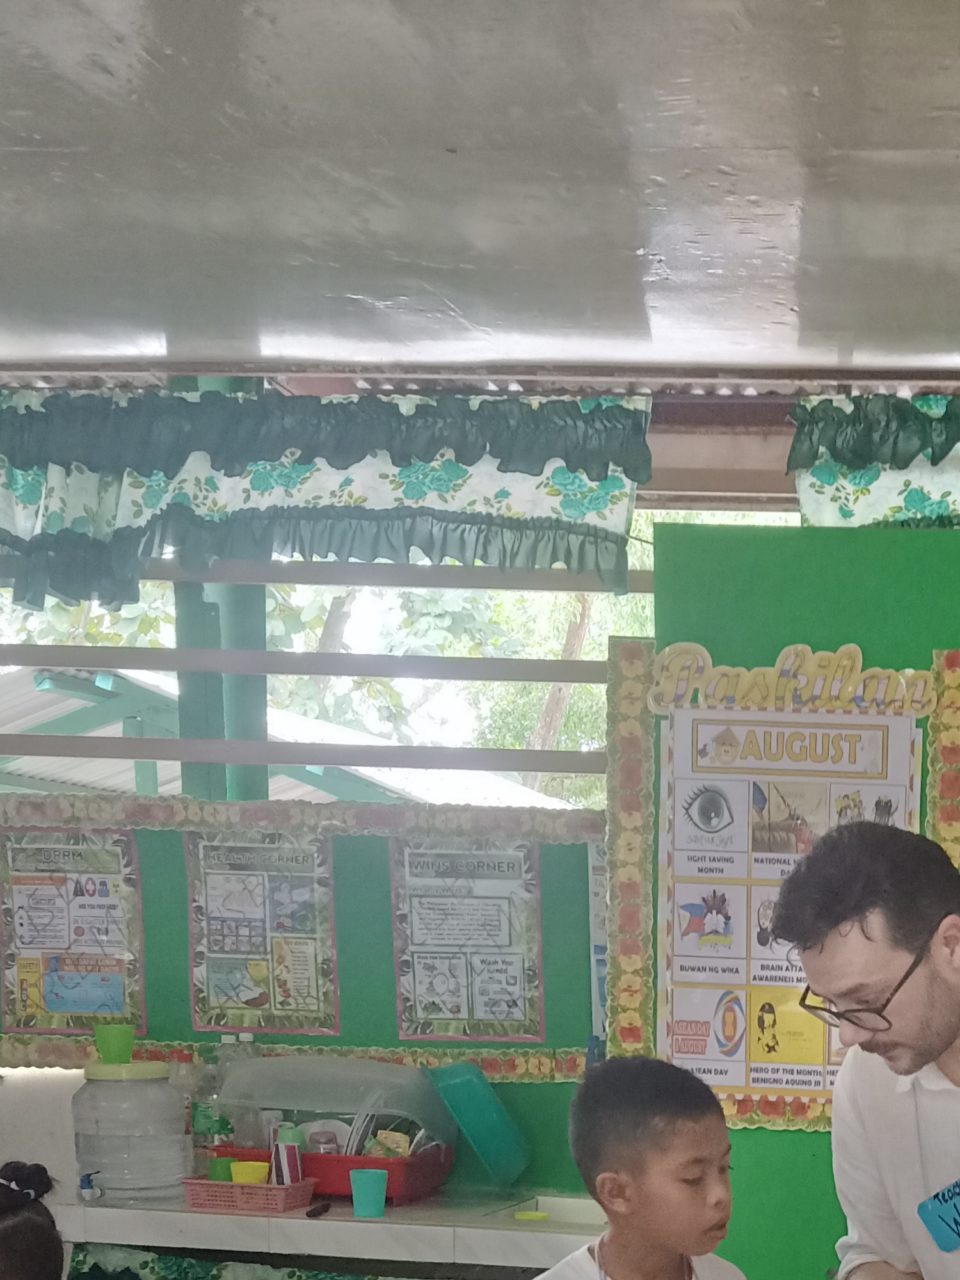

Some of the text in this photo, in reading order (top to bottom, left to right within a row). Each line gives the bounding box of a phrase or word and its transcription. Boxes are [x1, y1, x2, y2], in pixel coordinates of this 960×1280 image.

[739, 728, 862, 765] AUGUST
[261, 854, 309, 865] CORNER
[753, 857, 792, 866] NATIONAL
[455, 861, 516, 873] CORNER
[697, 866, 724, 874] MONTH
[679, 964, 740, 975] BUWAN NG WIKA
[760, 964, 784, 973] BRAIN
[752, 975, 795, 984] AWARENESS
[713, 1068, 729, 1076] DAY
[782, 1068, 795, 1076] THE
[796, 1069, 822, 1077] MONTH
[752, 1077, 783, 1086] BENIGNO
